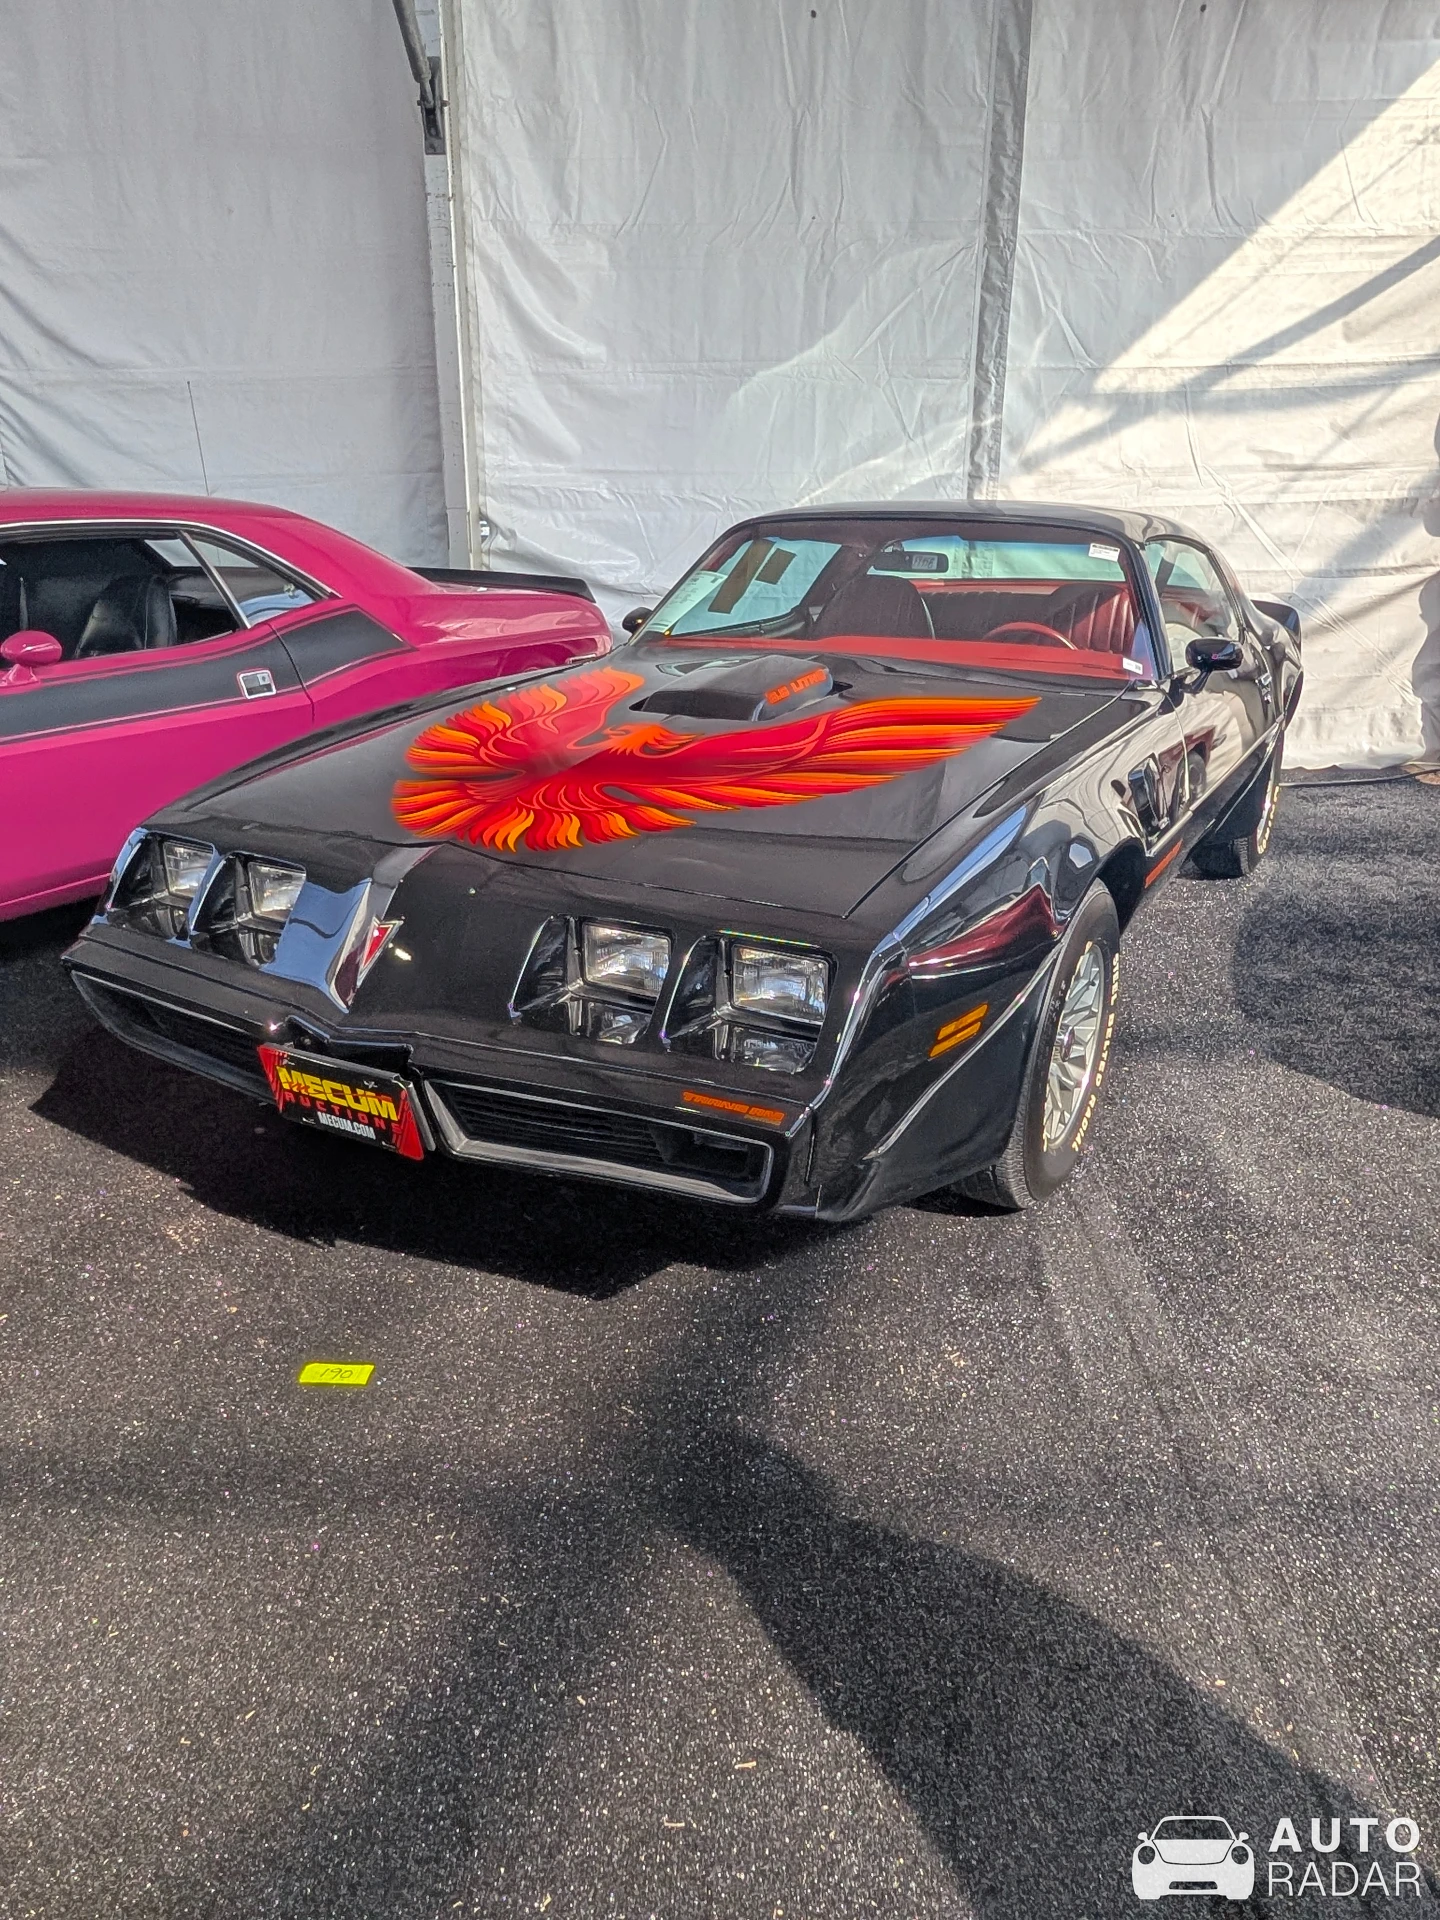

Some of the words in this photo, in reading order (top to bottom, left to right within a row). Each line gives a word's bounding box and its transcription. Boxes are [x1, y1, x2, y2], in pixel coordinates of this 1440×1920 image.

[1111, 953, 1120, 1006] STEEL
[1095, 1012, 1116, 1088] BELTED
[276, 1065, 399, 1121] MECUM
[283, 1091, 403, 1136] AUCTIONS
[317, 1112, 376, 1140] MECUM.COM
[1071, 1093, 1098, 1153] RADIAL
[320, 1368, 353, 1379] 190
